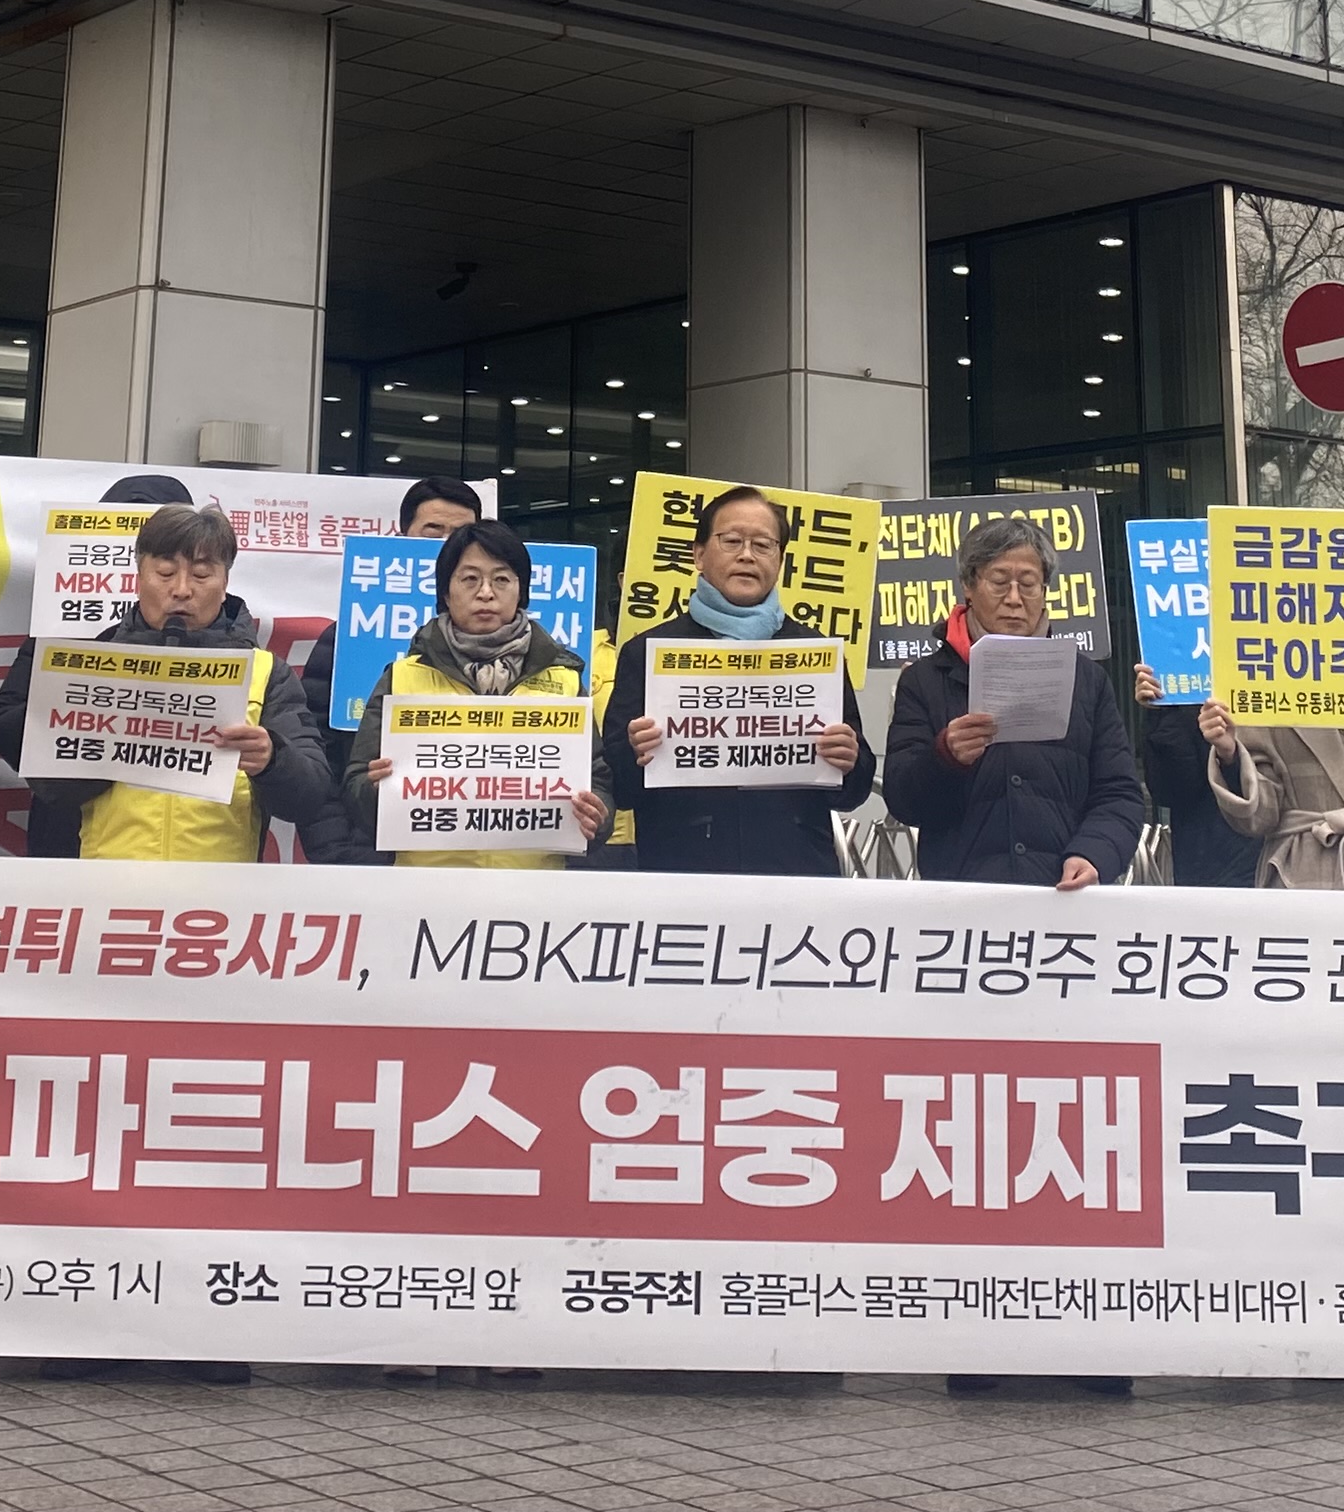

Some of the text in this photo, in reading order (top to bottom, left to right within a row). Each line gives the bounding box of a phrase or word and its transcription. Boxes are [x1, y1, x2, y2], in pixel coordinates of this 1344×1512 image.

[54, 515, 111, 530] 홈플러스
[254, 510, 309, 529] 마트산업
[255, 529, 310, 547] 노동조합
[68, 544, 136, 566] 금융감
[1139, 539, 1209, 574] 부실
[55, 572, 115, 593] MBK
[61, 600, 104, 621] 엄중
[662, 652, 831, 669] 홈플러스 먹튀! 금융사기!
[879, 640, 933, 660] [홈플러스
[51, 652, 239, 679] 홈플러스 먹튀! 금융사기!
[65, 683, 216, 719] 금융감독원은
[678, 684, 816, 709] 금융감독원은
[1230, 690, 1291, 714] [홈플러스
[49, 708, 224, 745] MBK 파트너스
[399, 709, 579, 728] 홈플러스 먹튀! 금융사기!
[667, 714, 826, 738] MBK 파트너스
[55, 736, 212, 775] 엄중 제재하라
[415, 744, 561, 769] 금융감독원은
[674, 743, 817, 768] 엄중 제재하라
[402, 777, 572, 801] MBK 파트너스
[410, 807, 563, 832] 엄중 제재하라
[98, 908, 370, 992] 금융사기,
[410, 917, 898, 993] MBK파트너스와
[915, 928, 1098, 998] 김병주
[1110, 932, 1240, 1003] 회장
[1251, 940, 1311, 1000] 등
[579, 1064, 846, 1208] 엄중
[880, 1072, 1143, 1213] 제재
[22, 1259, 97, 1303] 오후
[106, 1260, 164, 1306] 1시
[205, 1262, 281, 1306] 장소
[299, 1264, 477, 1312] 금융감독원
[484, 1267, 521, 1313] 앞
[561, 1269, 703, 1317] 공동주최
[718, 1272, 858, 1318] 홈플러스
[861, 1274, 1097, 1322] 물품구매전단채
[1102, 1277, 1205, 1324] 피해자
[1209, 1279, 1308, 1325] 비대위
